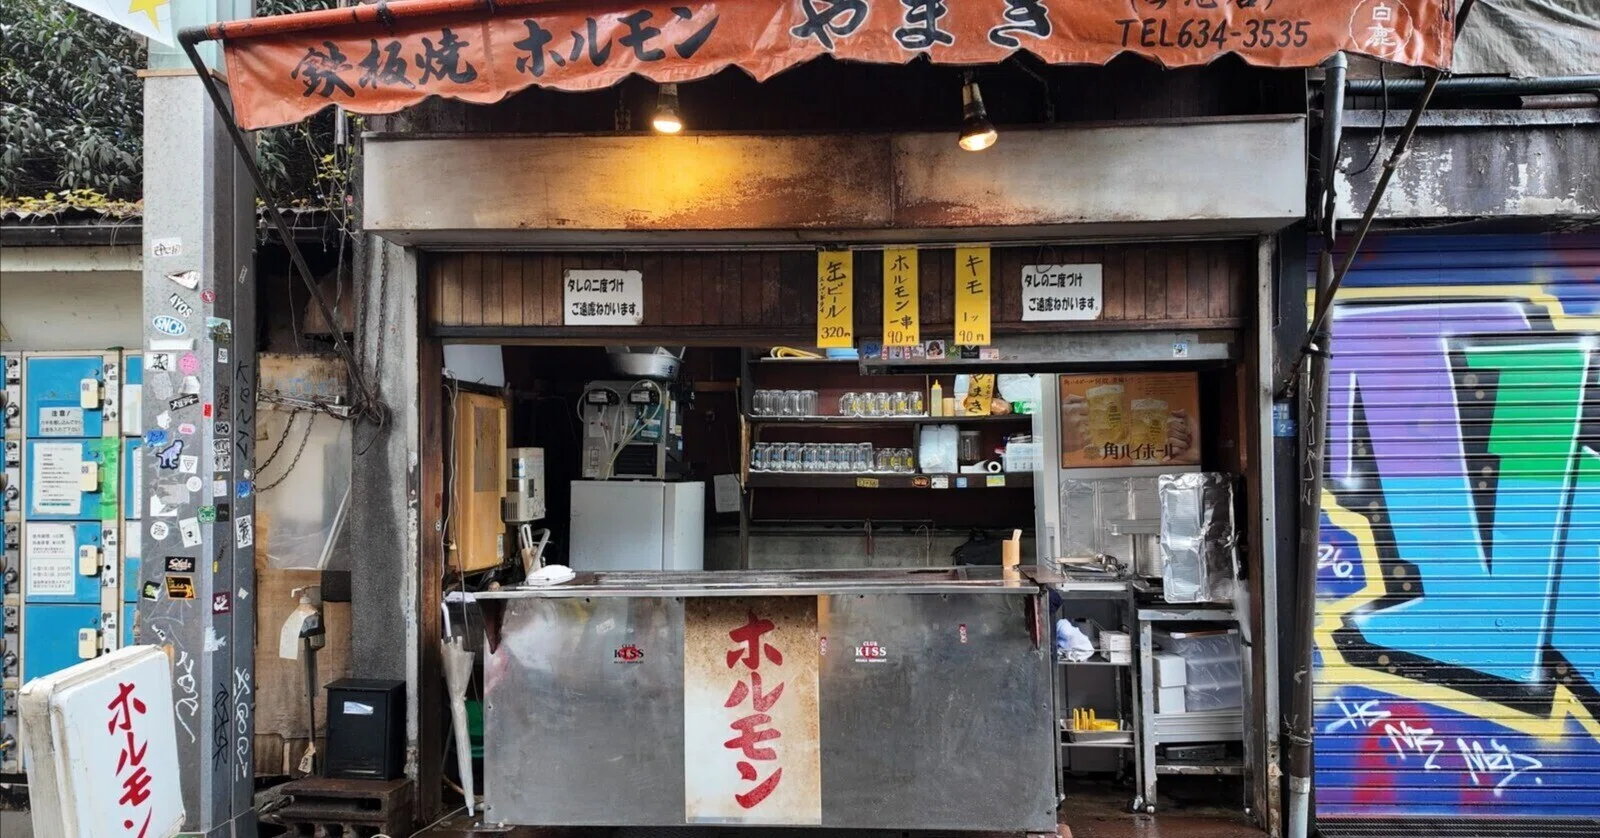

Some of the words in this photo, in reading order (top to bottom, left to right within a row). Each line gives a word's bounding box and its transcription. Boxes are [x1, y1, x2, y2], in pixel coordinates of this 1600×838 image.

[1115, 17, 1312, 49] TEL634-3535
[1365, 2, 1396, 47] 白鹿
[291, 27, 478, 98] 鉄板焼
[513, 6, 720, 78] ホルモン
[567, 278, 625, 293] タレの二度づけ
[890, 254, 911, 312] ホルモン
[965, 254, 984, 295] キモ
[1024, 272, 1084, 289] タレの二度づけ
[825, 261, 848, 319] 缶ビール
[571, 301, 641, 317] ご遠慮ねがいます。
[1028, 296, 1099, 312] ご遠慮ねがいます。
[1102, 441, 1175, 460] 角ハイボール
[613, 649, 645, 658] KISS
[855, 646, 887, 656] KISS
[723, 611, 784, 809] ホルモン
